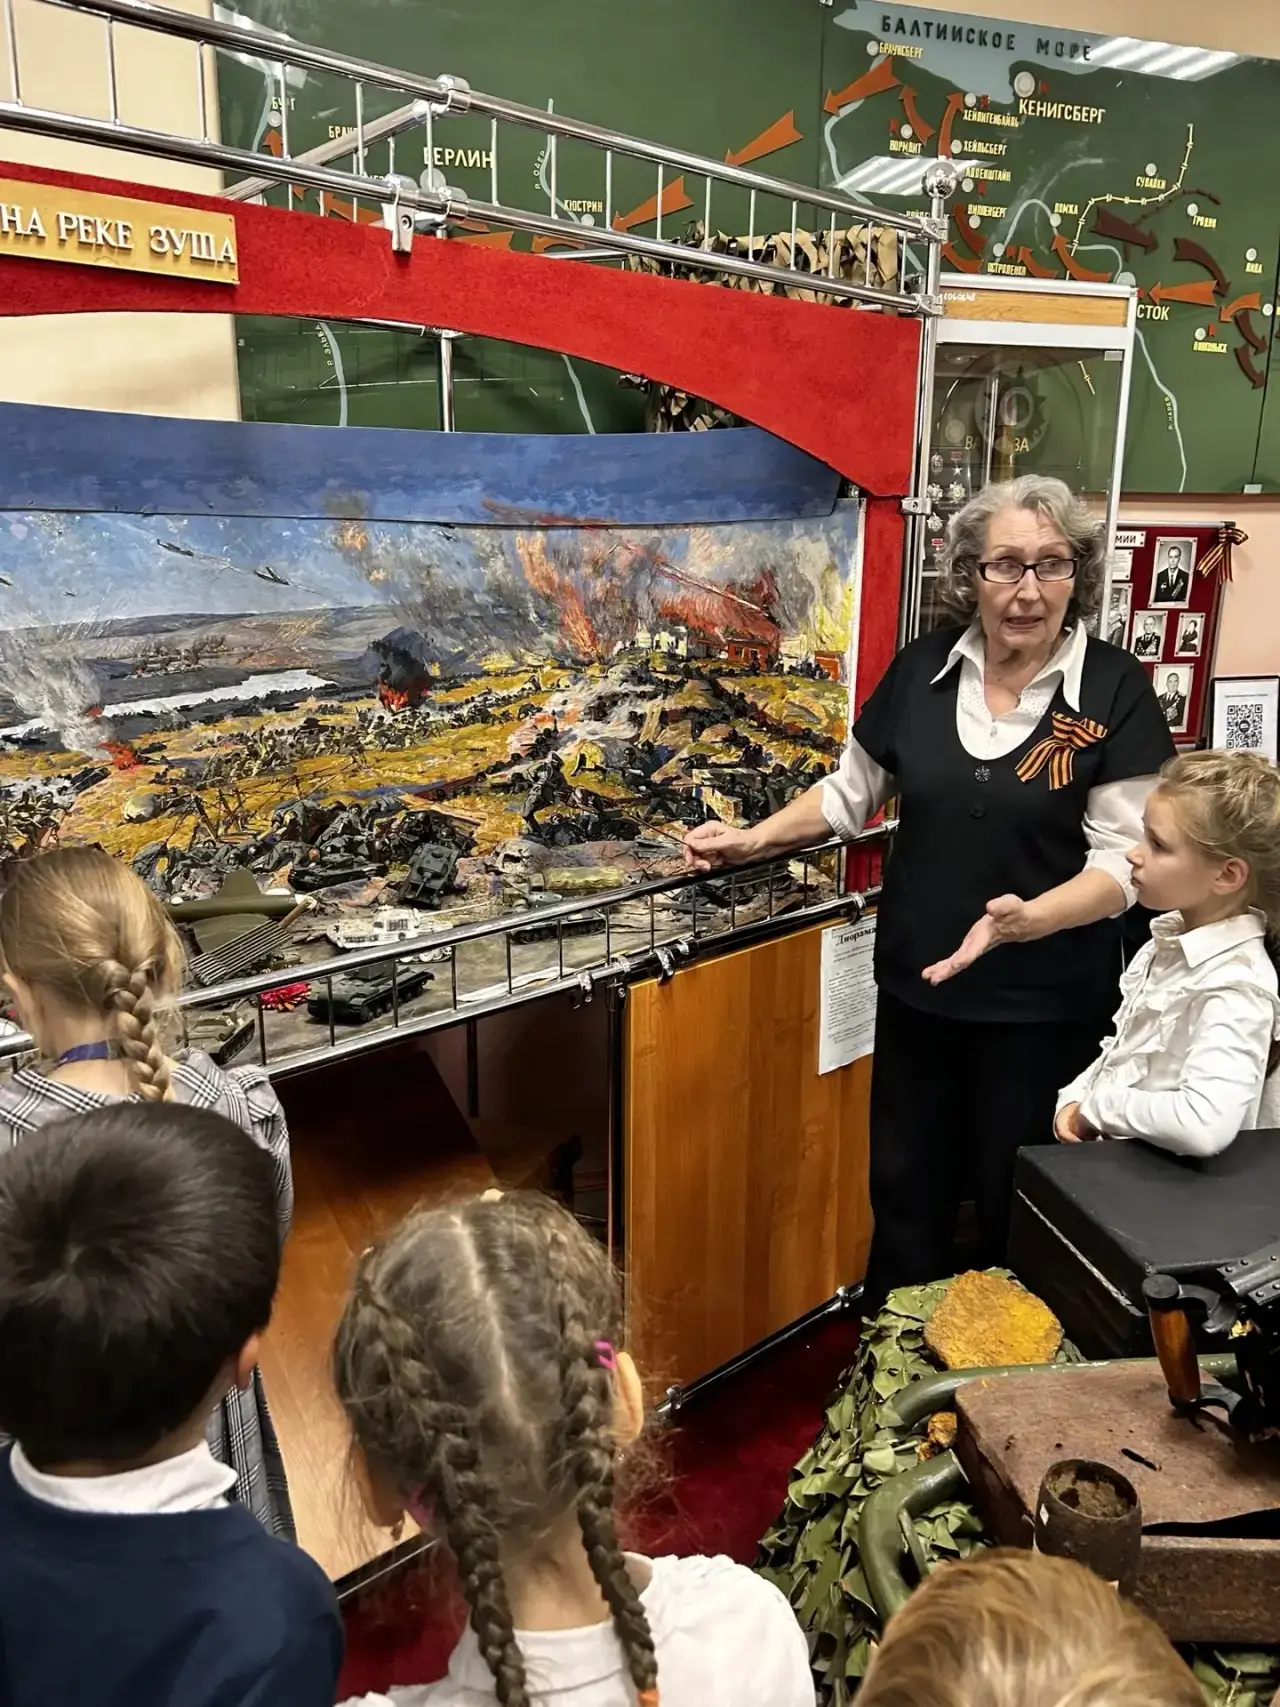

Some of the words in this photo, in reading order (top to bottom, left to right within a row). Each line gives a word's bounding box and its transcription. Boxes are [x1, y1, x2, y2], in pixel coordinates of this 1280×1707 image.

[879, 43, 924, 59] БРАУНСБЕРГ
[1036, 38, 1091, 61] МОРЕ
[1019, 99, 1106, 124] КЕНИГСБЕРГ
[963, 140, 1008, 156] ХЕЙЛЬСБЕРГ
[533, 150, 545, 176] ОДЕР
[564, 200, 603, 213] КЮСТРИН
[0, 204, 48, 238] НА
[57, 211, 134, 250] РЕКЕ
[150, 226, 236, 264] ЗУША
[836, 927, 877, 946] Диорама
